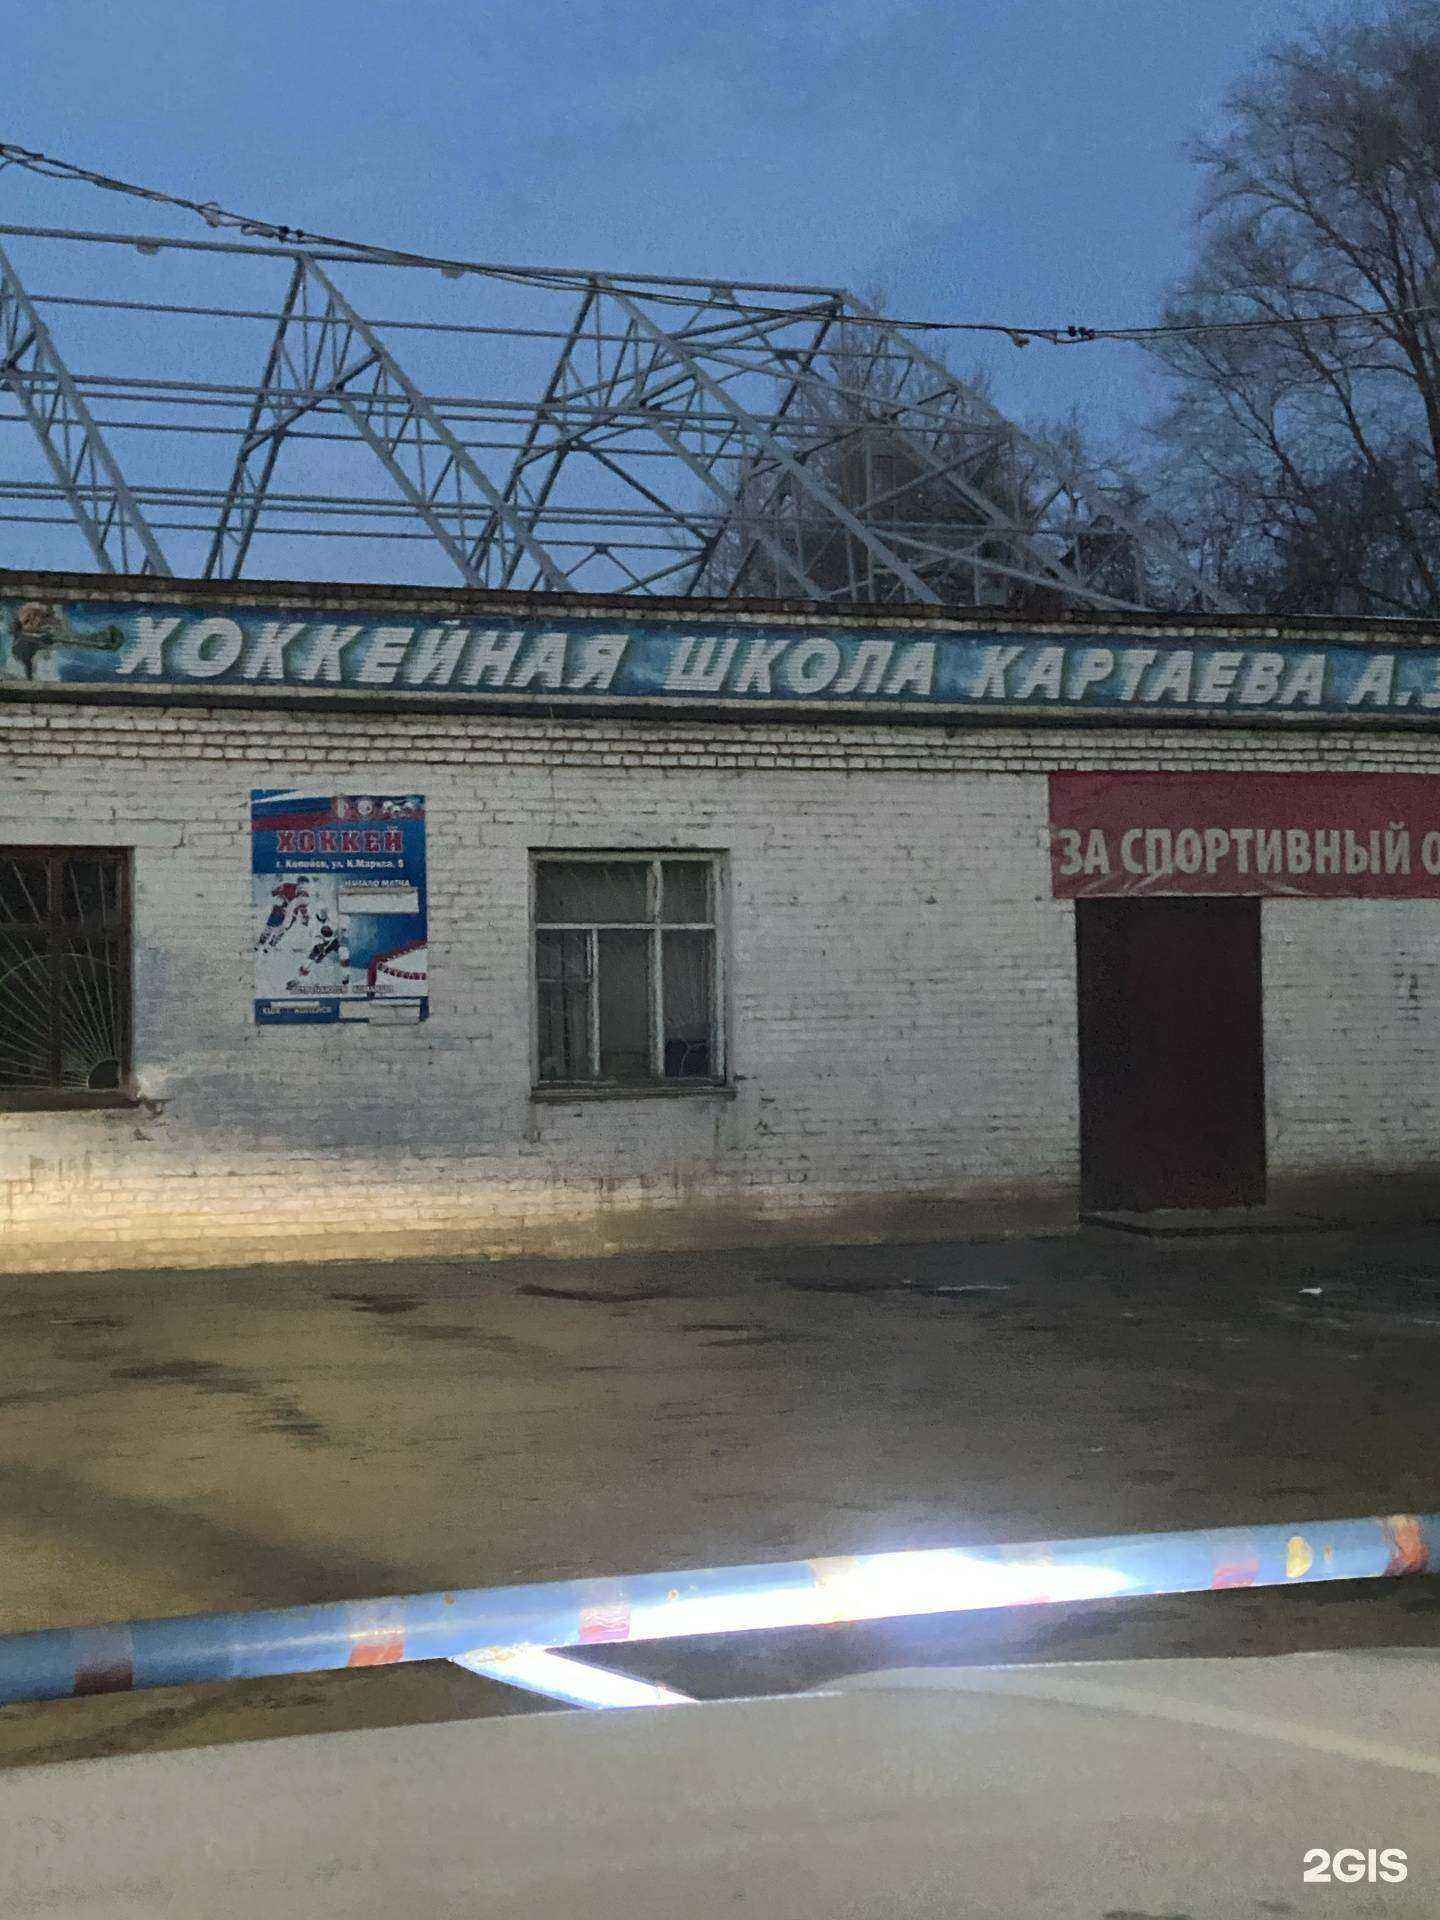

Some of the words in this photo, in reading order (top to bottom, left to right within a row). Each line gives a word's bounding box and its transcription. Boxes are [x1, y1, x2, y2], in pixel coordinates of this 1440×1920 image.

[116, 616, 629, 690] ХОККЕЙНАЯ
[661, 636, 937, 696] ШКОЛА
[971, 643, 1326, 706] КАРТАЕВА
[276, 826, 404, 853] ХОККЕЙ
[1055, 828, 1110, 876] ЗА
[1120, 821, 1411, 876] СПОРТИВНЫЙ
